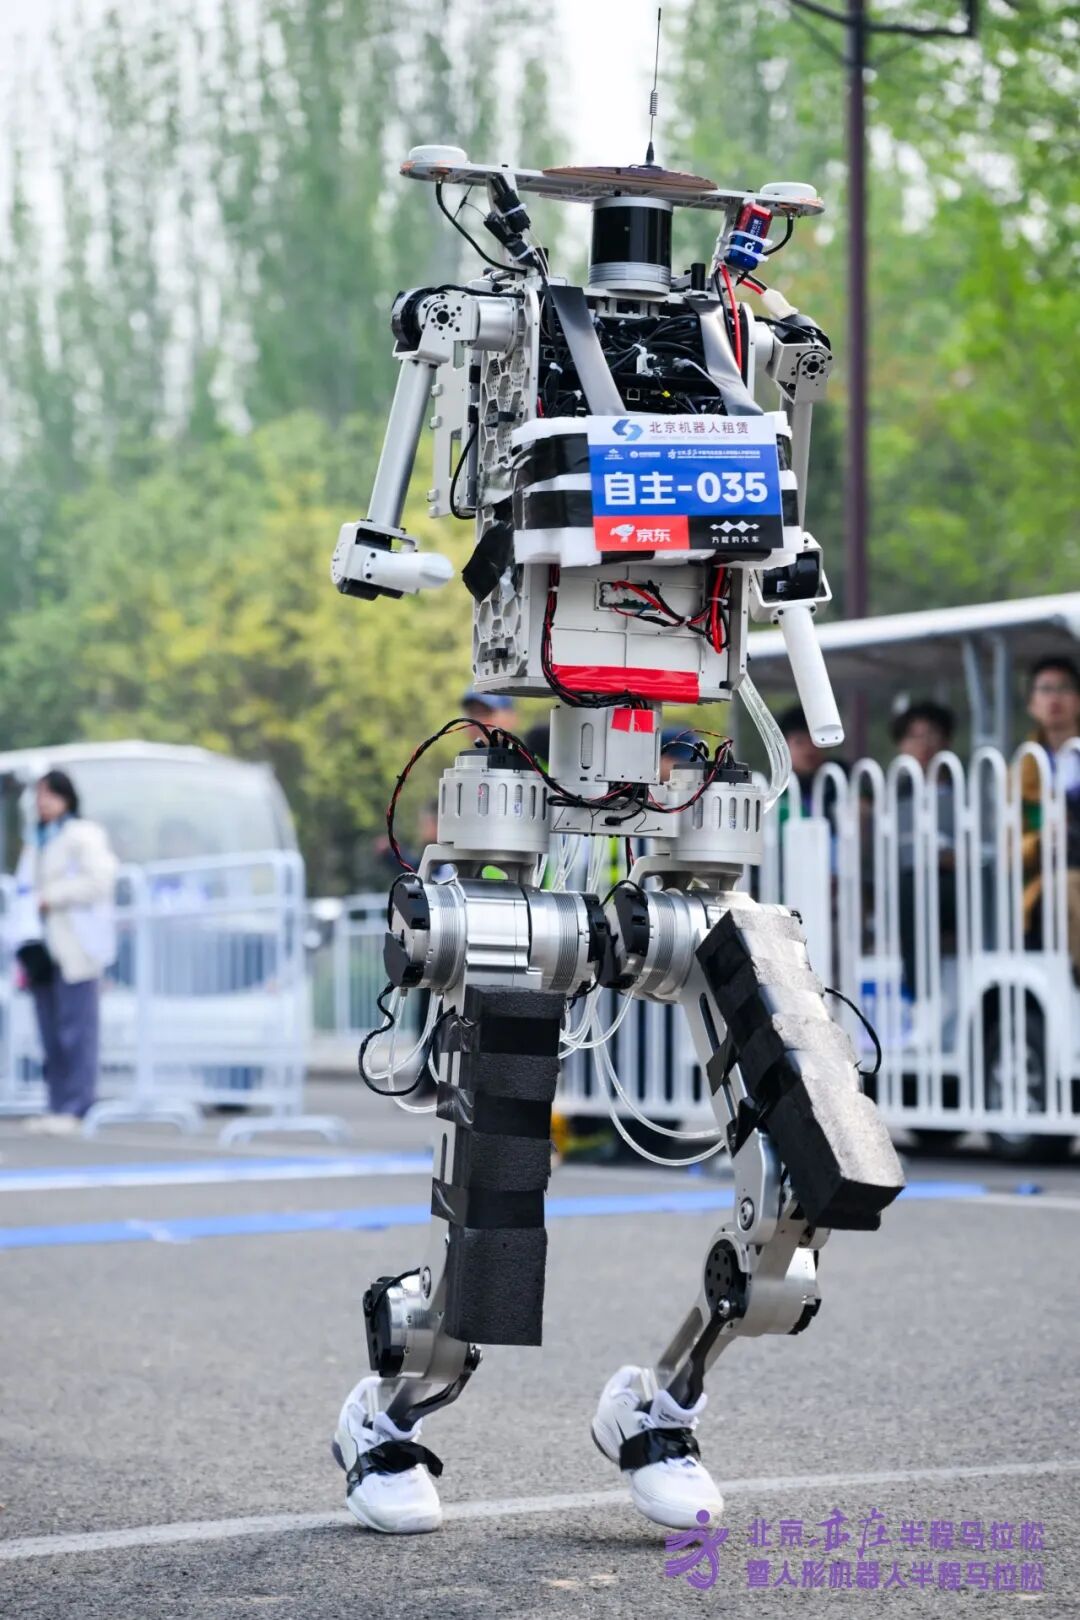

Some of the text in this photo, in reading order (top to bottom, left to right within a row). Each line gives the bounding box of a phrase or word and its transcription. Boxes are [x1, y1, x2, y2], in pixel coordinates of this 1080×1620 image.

[649, 421, 749, 434] 北京机器人租赁
[604, 471, 768, 505] 自主-035
[636, 528, 671, 543] 京东
